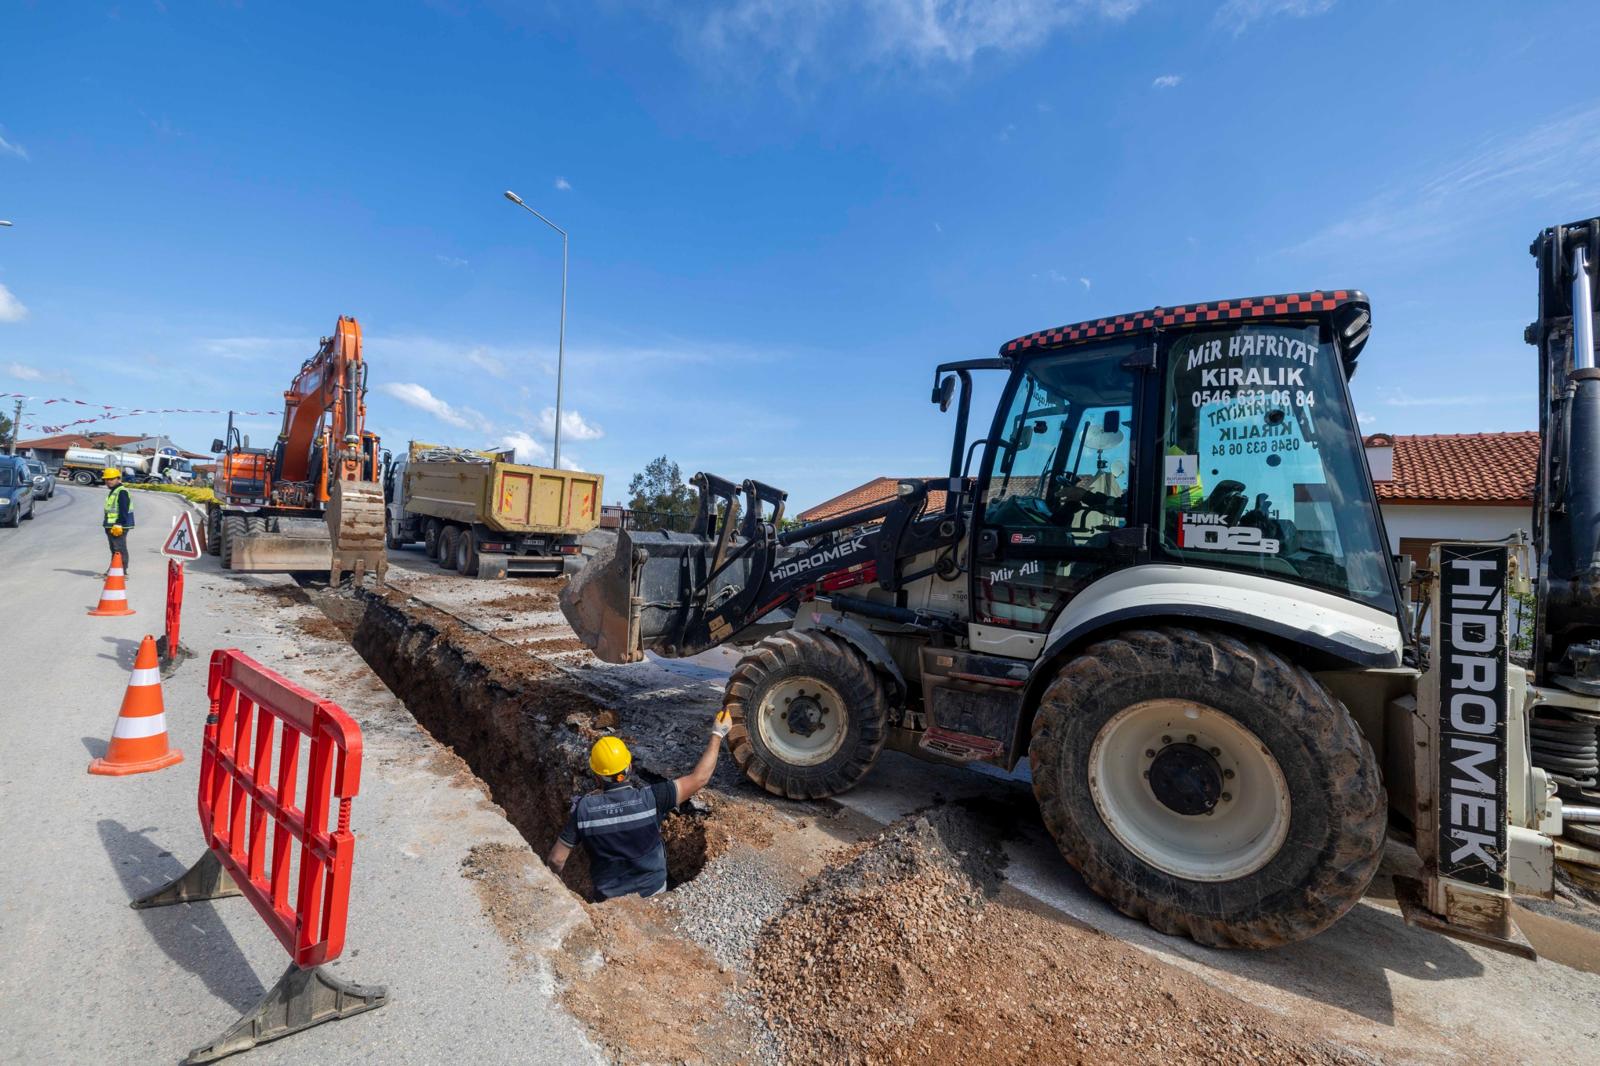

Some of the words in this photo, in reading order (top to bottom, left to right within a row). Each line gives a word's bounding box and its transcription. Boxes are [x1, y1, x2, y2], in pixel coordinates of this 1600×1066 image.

[1191, 389, 1231, 408] 0546
[1236, 389, 1265, 406] 633
[1271, 389, 1290, 407] 06
[1295, 390, 1315, 408] 84
[1182, 512, 1229, 525] HMK
[990, 567, 1014, 586] Mir
[1019, 559, 1039, 577] Ali
